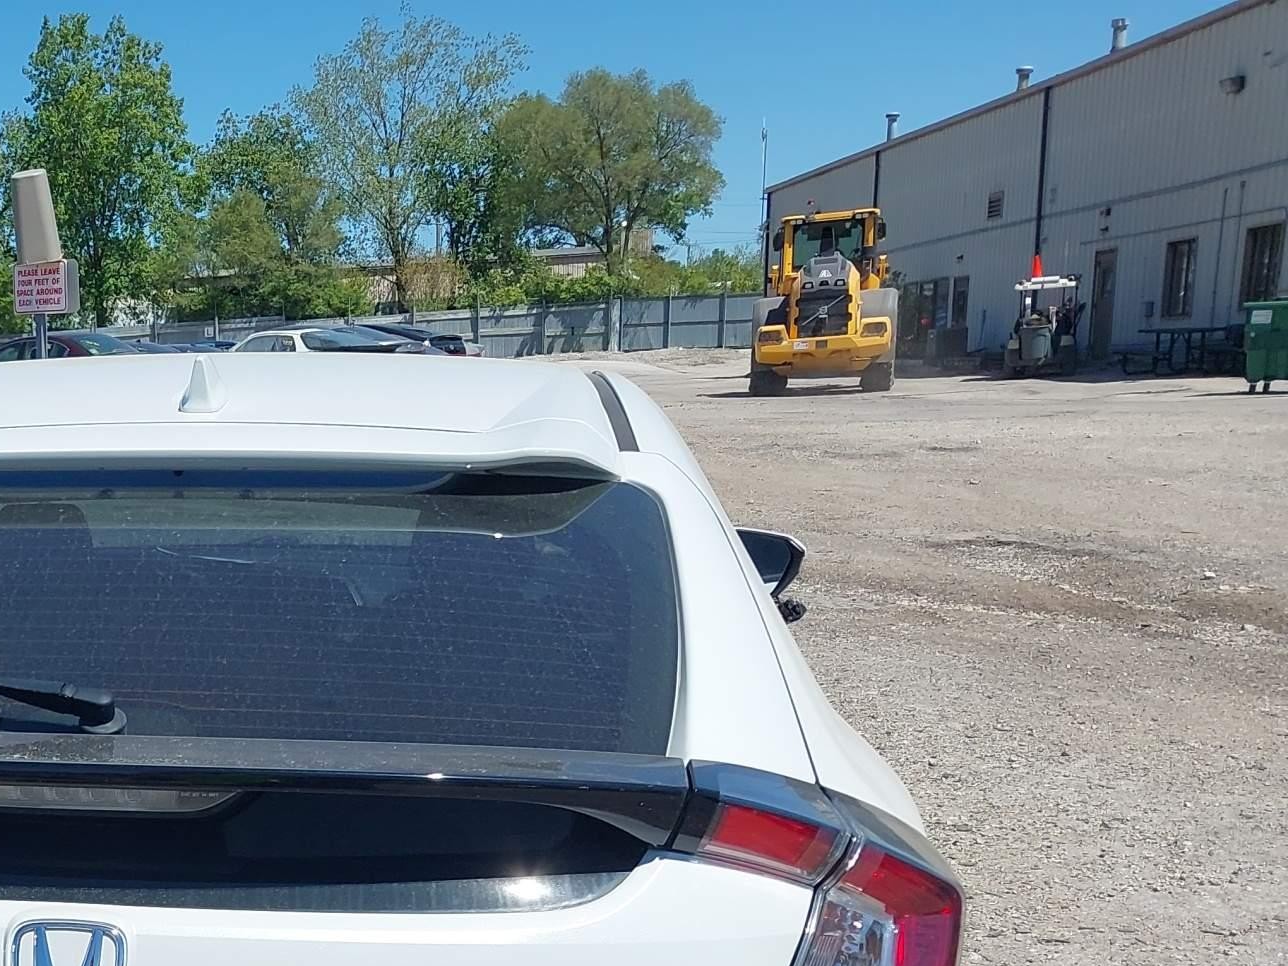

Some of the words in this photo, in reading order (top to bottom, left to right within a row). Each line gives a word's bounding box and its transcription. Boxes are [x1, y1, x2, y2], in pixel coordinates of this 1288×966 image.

[18, 269, 39, 277] PLEASE
[40, 267, 61, 276] LEAVE
[34, 278, 49, 286] FEET
[51, 277, 60, 285] OF
[17, 288, 34, 297] SPACE
[36, 287, 63, 296] AROUND
[35, 297, 62, 306] VEHICLE
